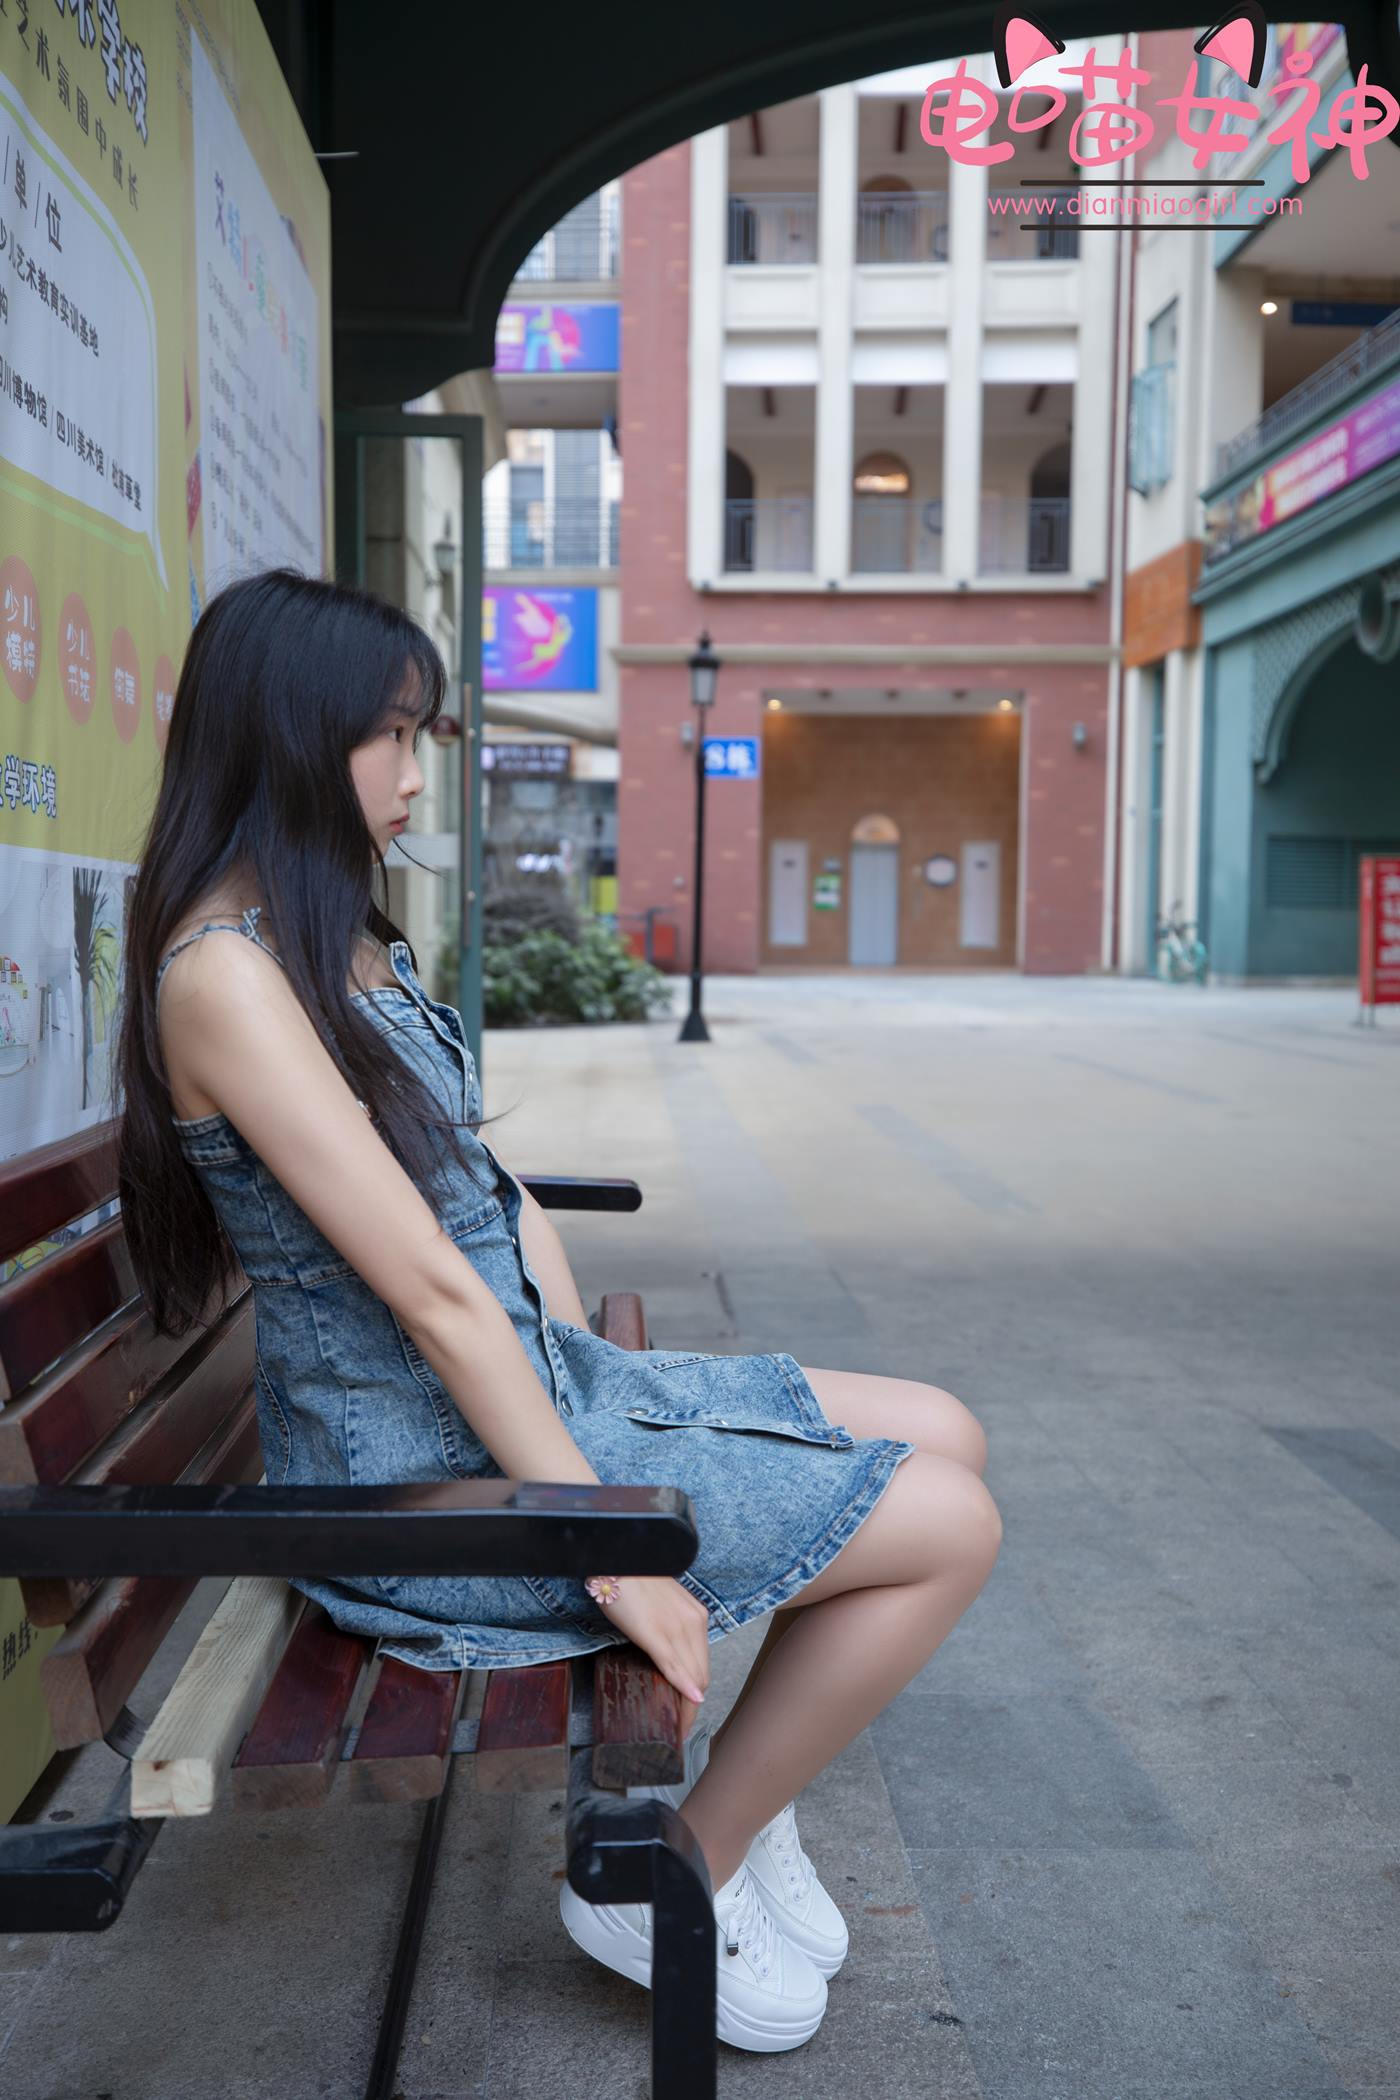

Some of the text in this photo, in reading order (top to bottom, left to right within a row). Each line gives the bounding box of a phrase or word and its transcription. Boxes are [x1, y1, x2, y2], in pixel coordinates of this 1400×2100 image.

[0, 355, 48, 428] 川博物馆
[56, 410, 105, 476] 四川美术馆
[0, 754, 56, 818] 学环境
